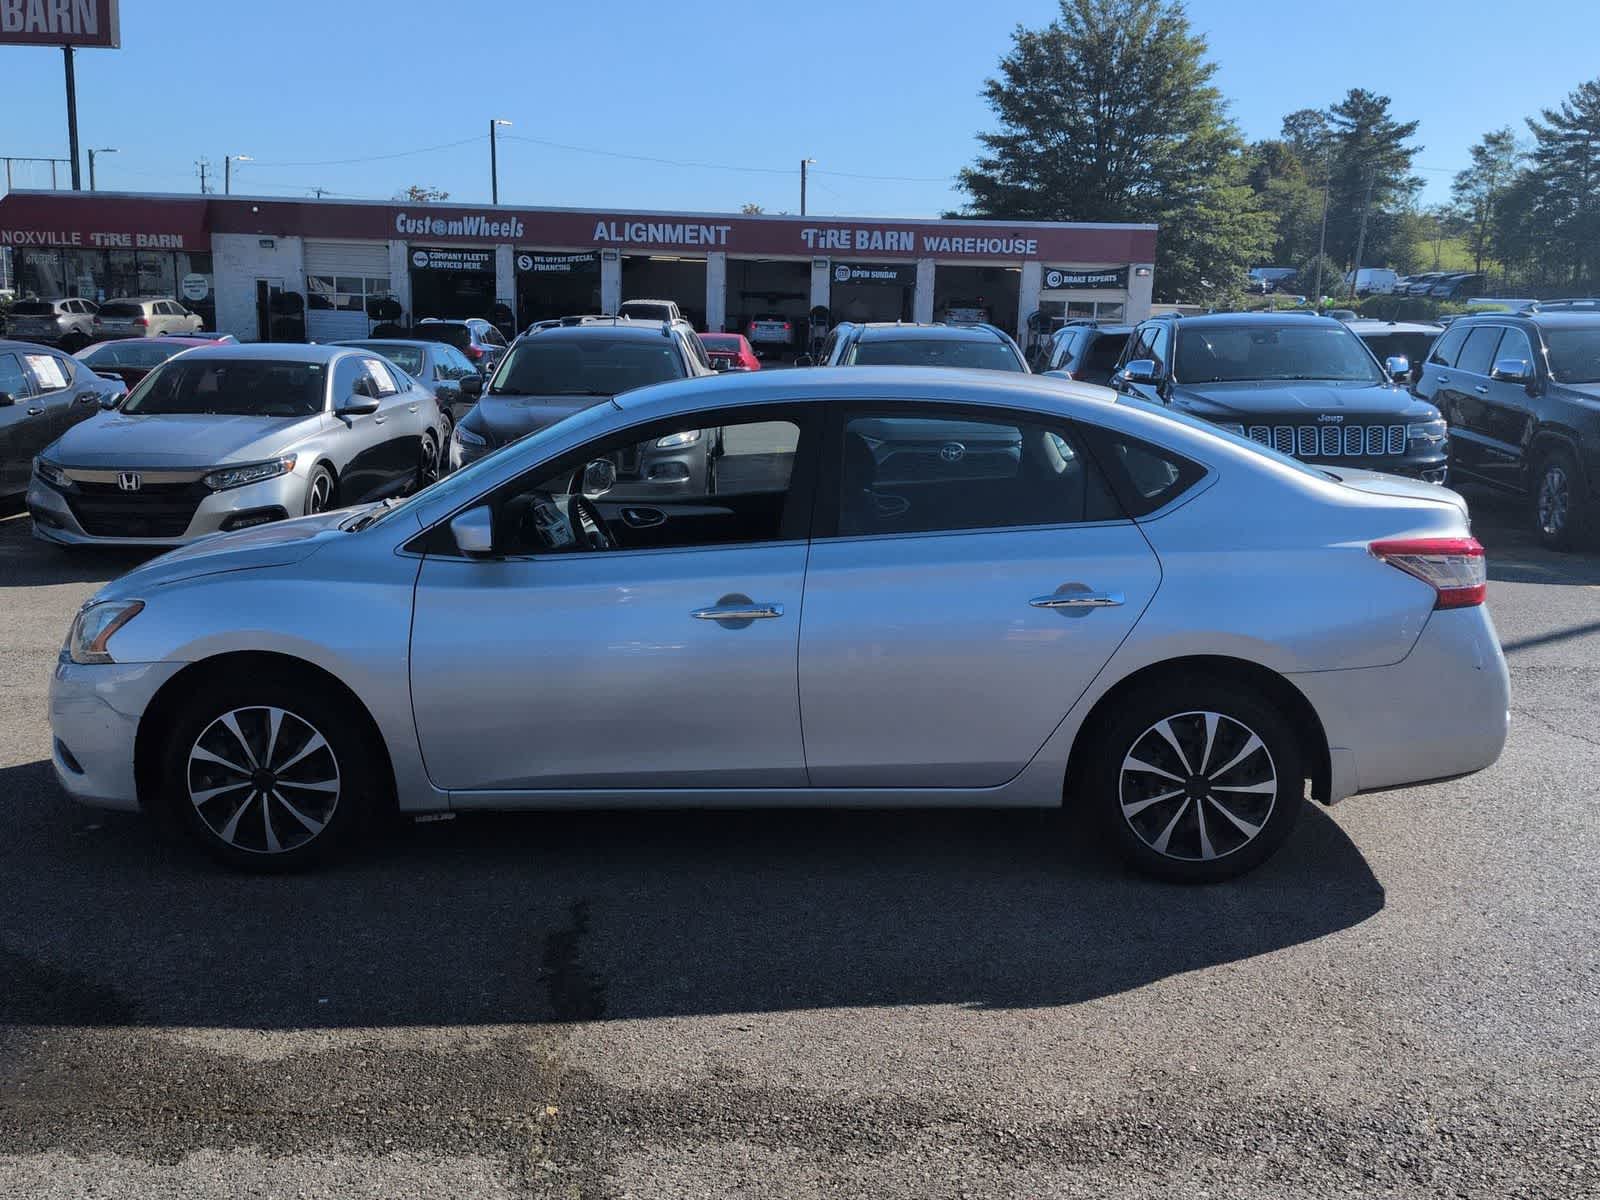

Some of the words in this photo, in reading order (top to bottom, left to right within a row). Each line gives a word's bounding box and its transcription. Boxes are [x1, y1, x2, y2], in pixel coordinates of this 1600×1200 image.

[1, 0, 98, 34] BARN
[395, 213, 525, 239] CustomWheels
[593, 221, 731, 246] ALIGNMENT
[136, 234, 184, 249] BARN
[855, 230, 915, 252] BARN
[922, 236, 1039, 255] WAREHOUSE
[429, 252, 462, 261] COMPANY
[463, 253, 489, 261] FLEETS
[567, 254, 595, 263] SPECIAL
[429, 261, 463, 269] SERVICED
[463, 261, 481, 270] HERE
[534, 264, 571, 272] FINANCING
[852, 270, 870, 278] OPEN
[871, 271, 897, 279] SUNDAY
[1317, 414, 1344, 424] Jeep
